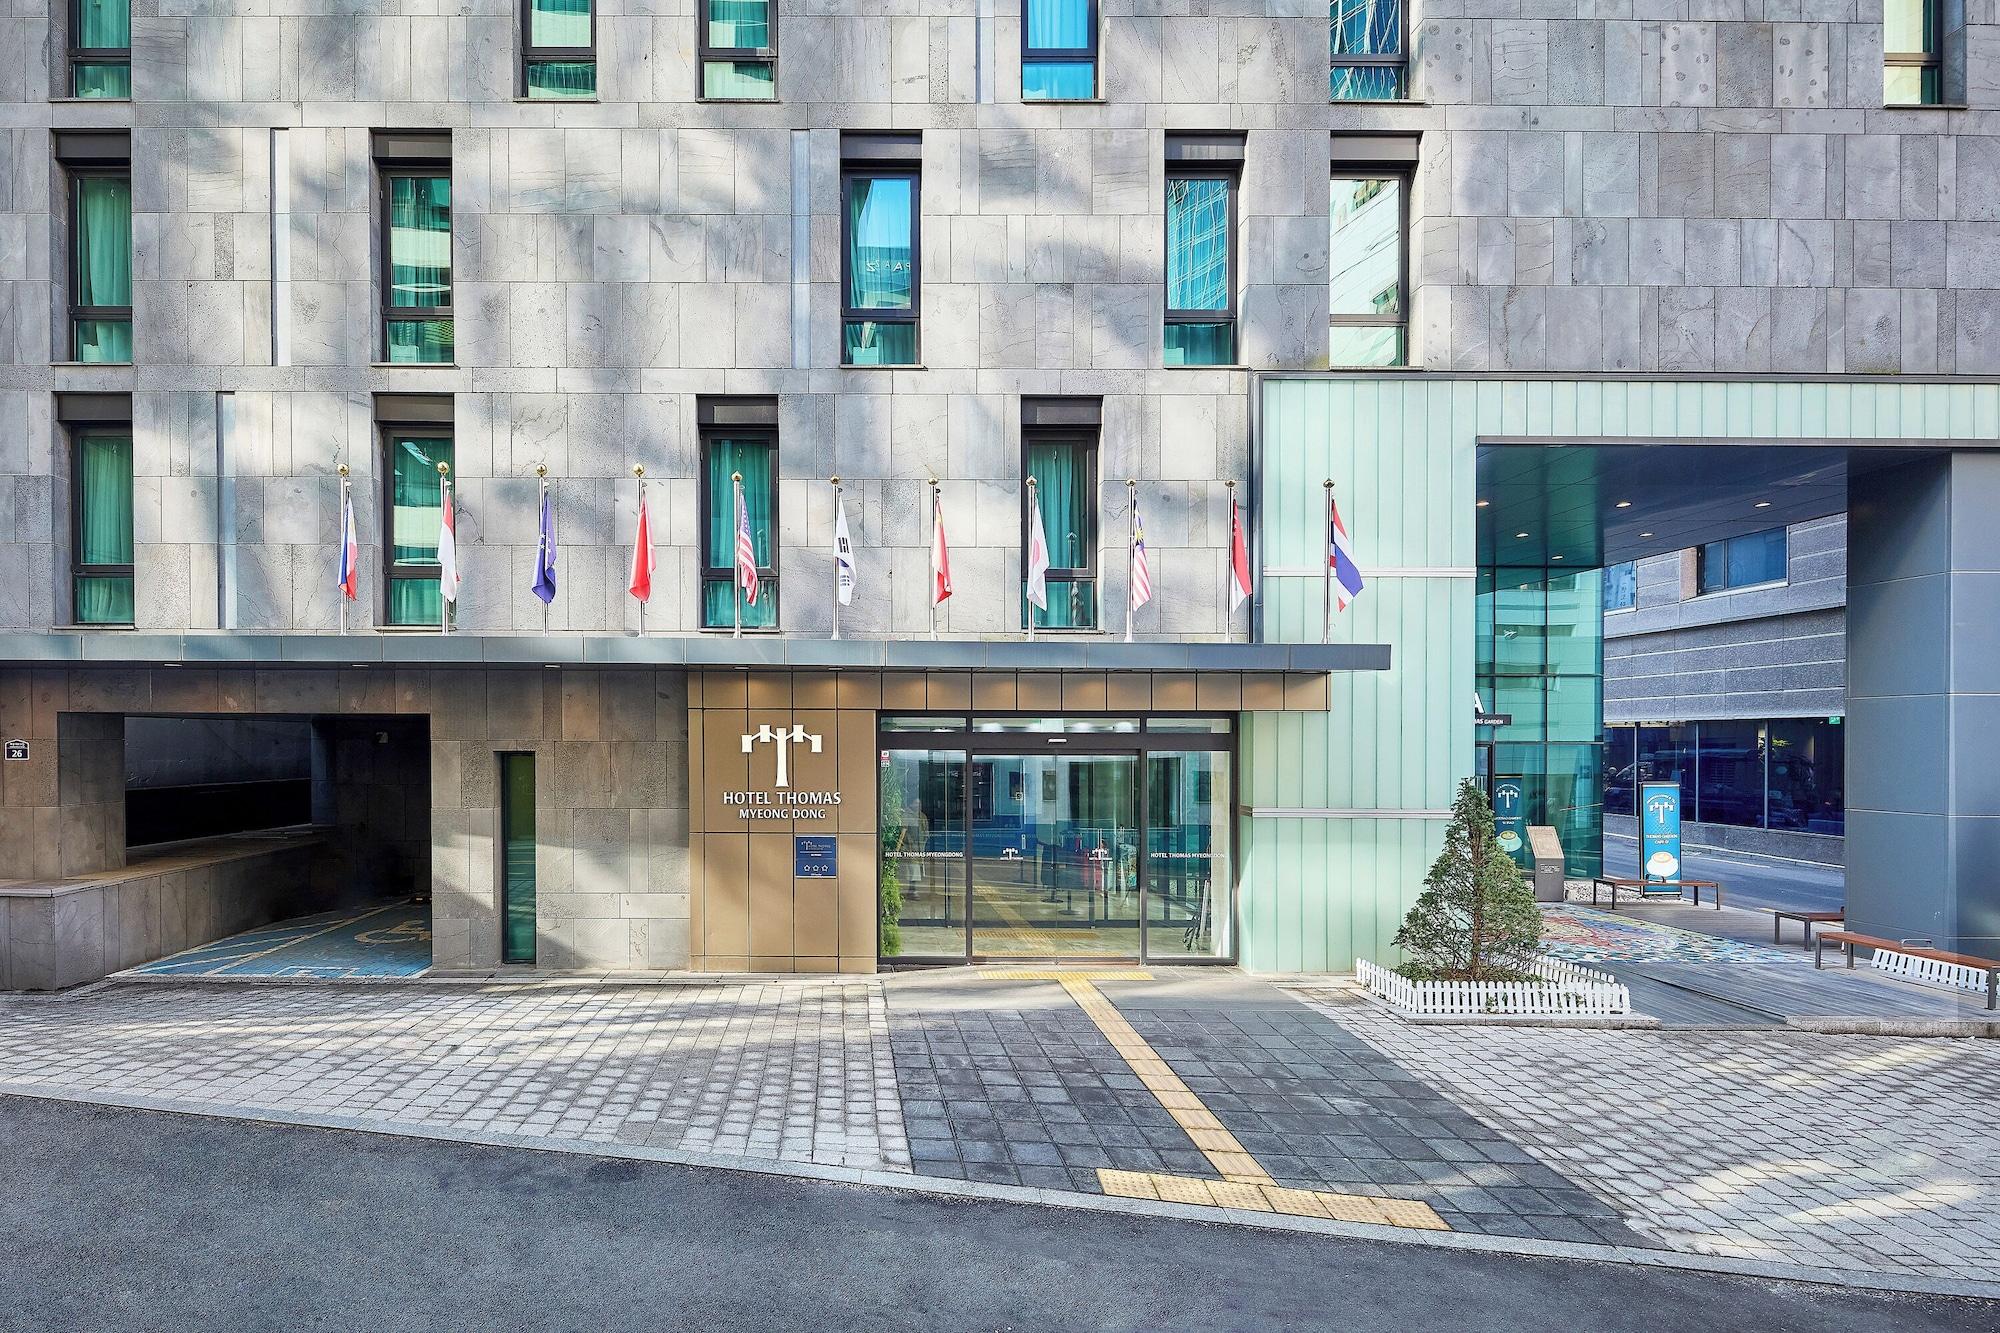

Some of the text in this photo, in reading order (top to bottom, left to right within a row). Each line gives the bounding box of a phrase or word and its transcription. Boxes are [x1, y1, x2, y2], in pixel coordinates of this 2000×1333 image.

[12, 750, 22, 758] 26
[723, 791, 842, 805] HOTEL THOMAS
[739, 808, 826, 819] MYEONG DONG
